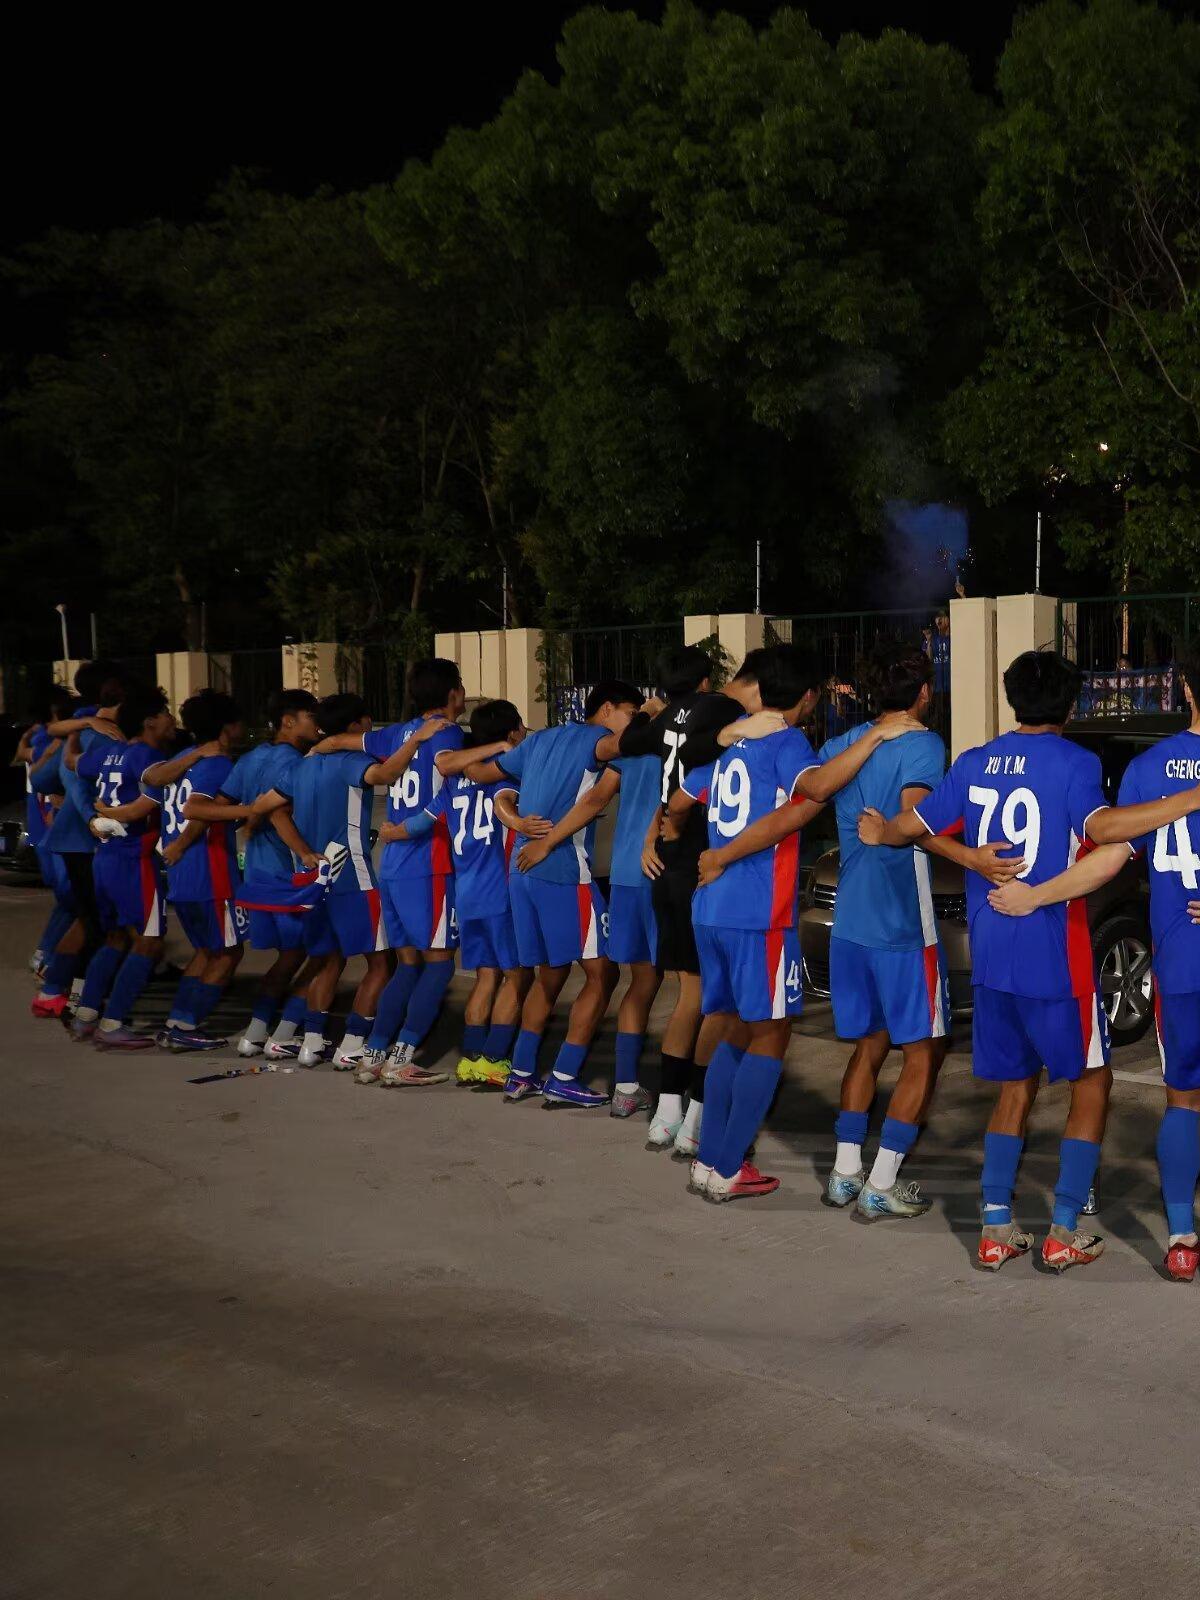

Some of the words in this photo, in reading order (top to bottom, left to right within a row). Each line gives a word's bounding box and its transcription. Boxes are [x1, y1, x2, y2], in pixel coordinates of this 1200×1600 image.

[708, 759, 751, 837] 49
[985, 756, 1001, 774] XU
[1004, 756, 1026, 774] Y.M.
[453, 790, 495, 856] 74
[968, 785, 1041, 879] 79
